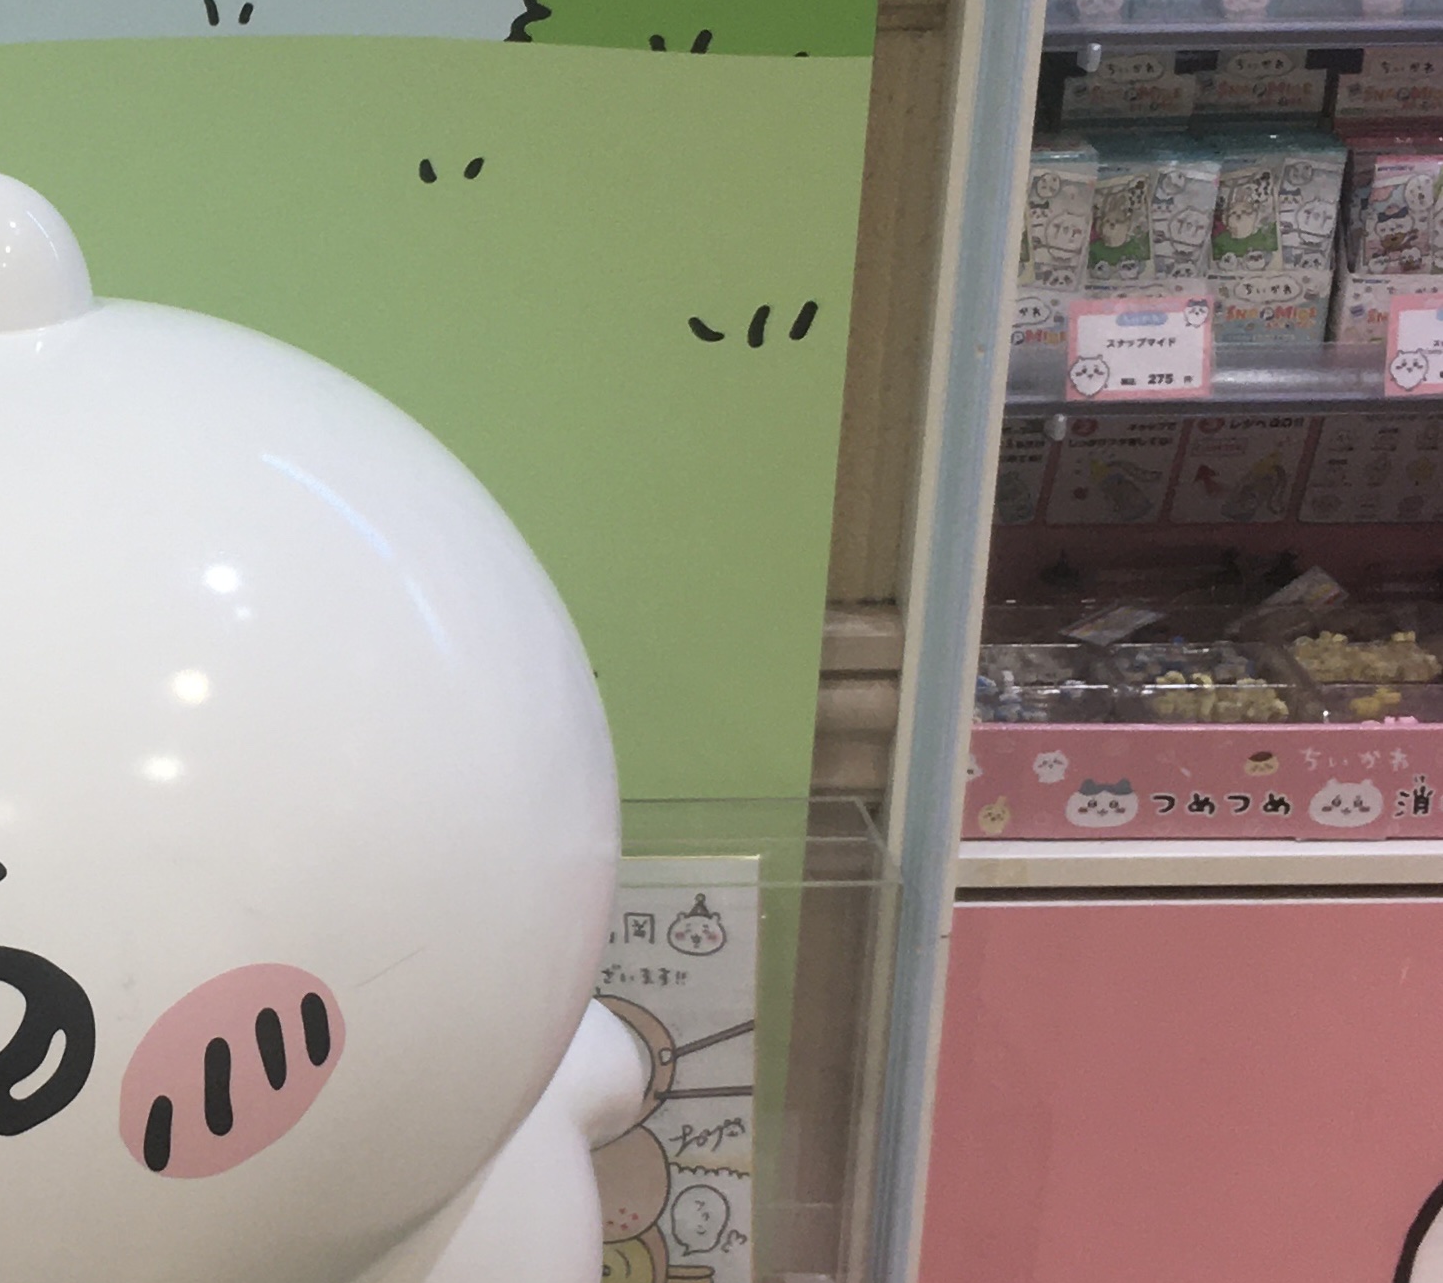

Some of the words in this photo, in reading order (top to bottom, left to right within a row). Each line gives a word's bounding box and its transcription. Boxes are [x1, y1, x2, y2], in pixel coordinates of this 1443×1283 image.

[1148, 373, 1174, 385] 275
[1152, 792, 1292, 817] つめつめ
